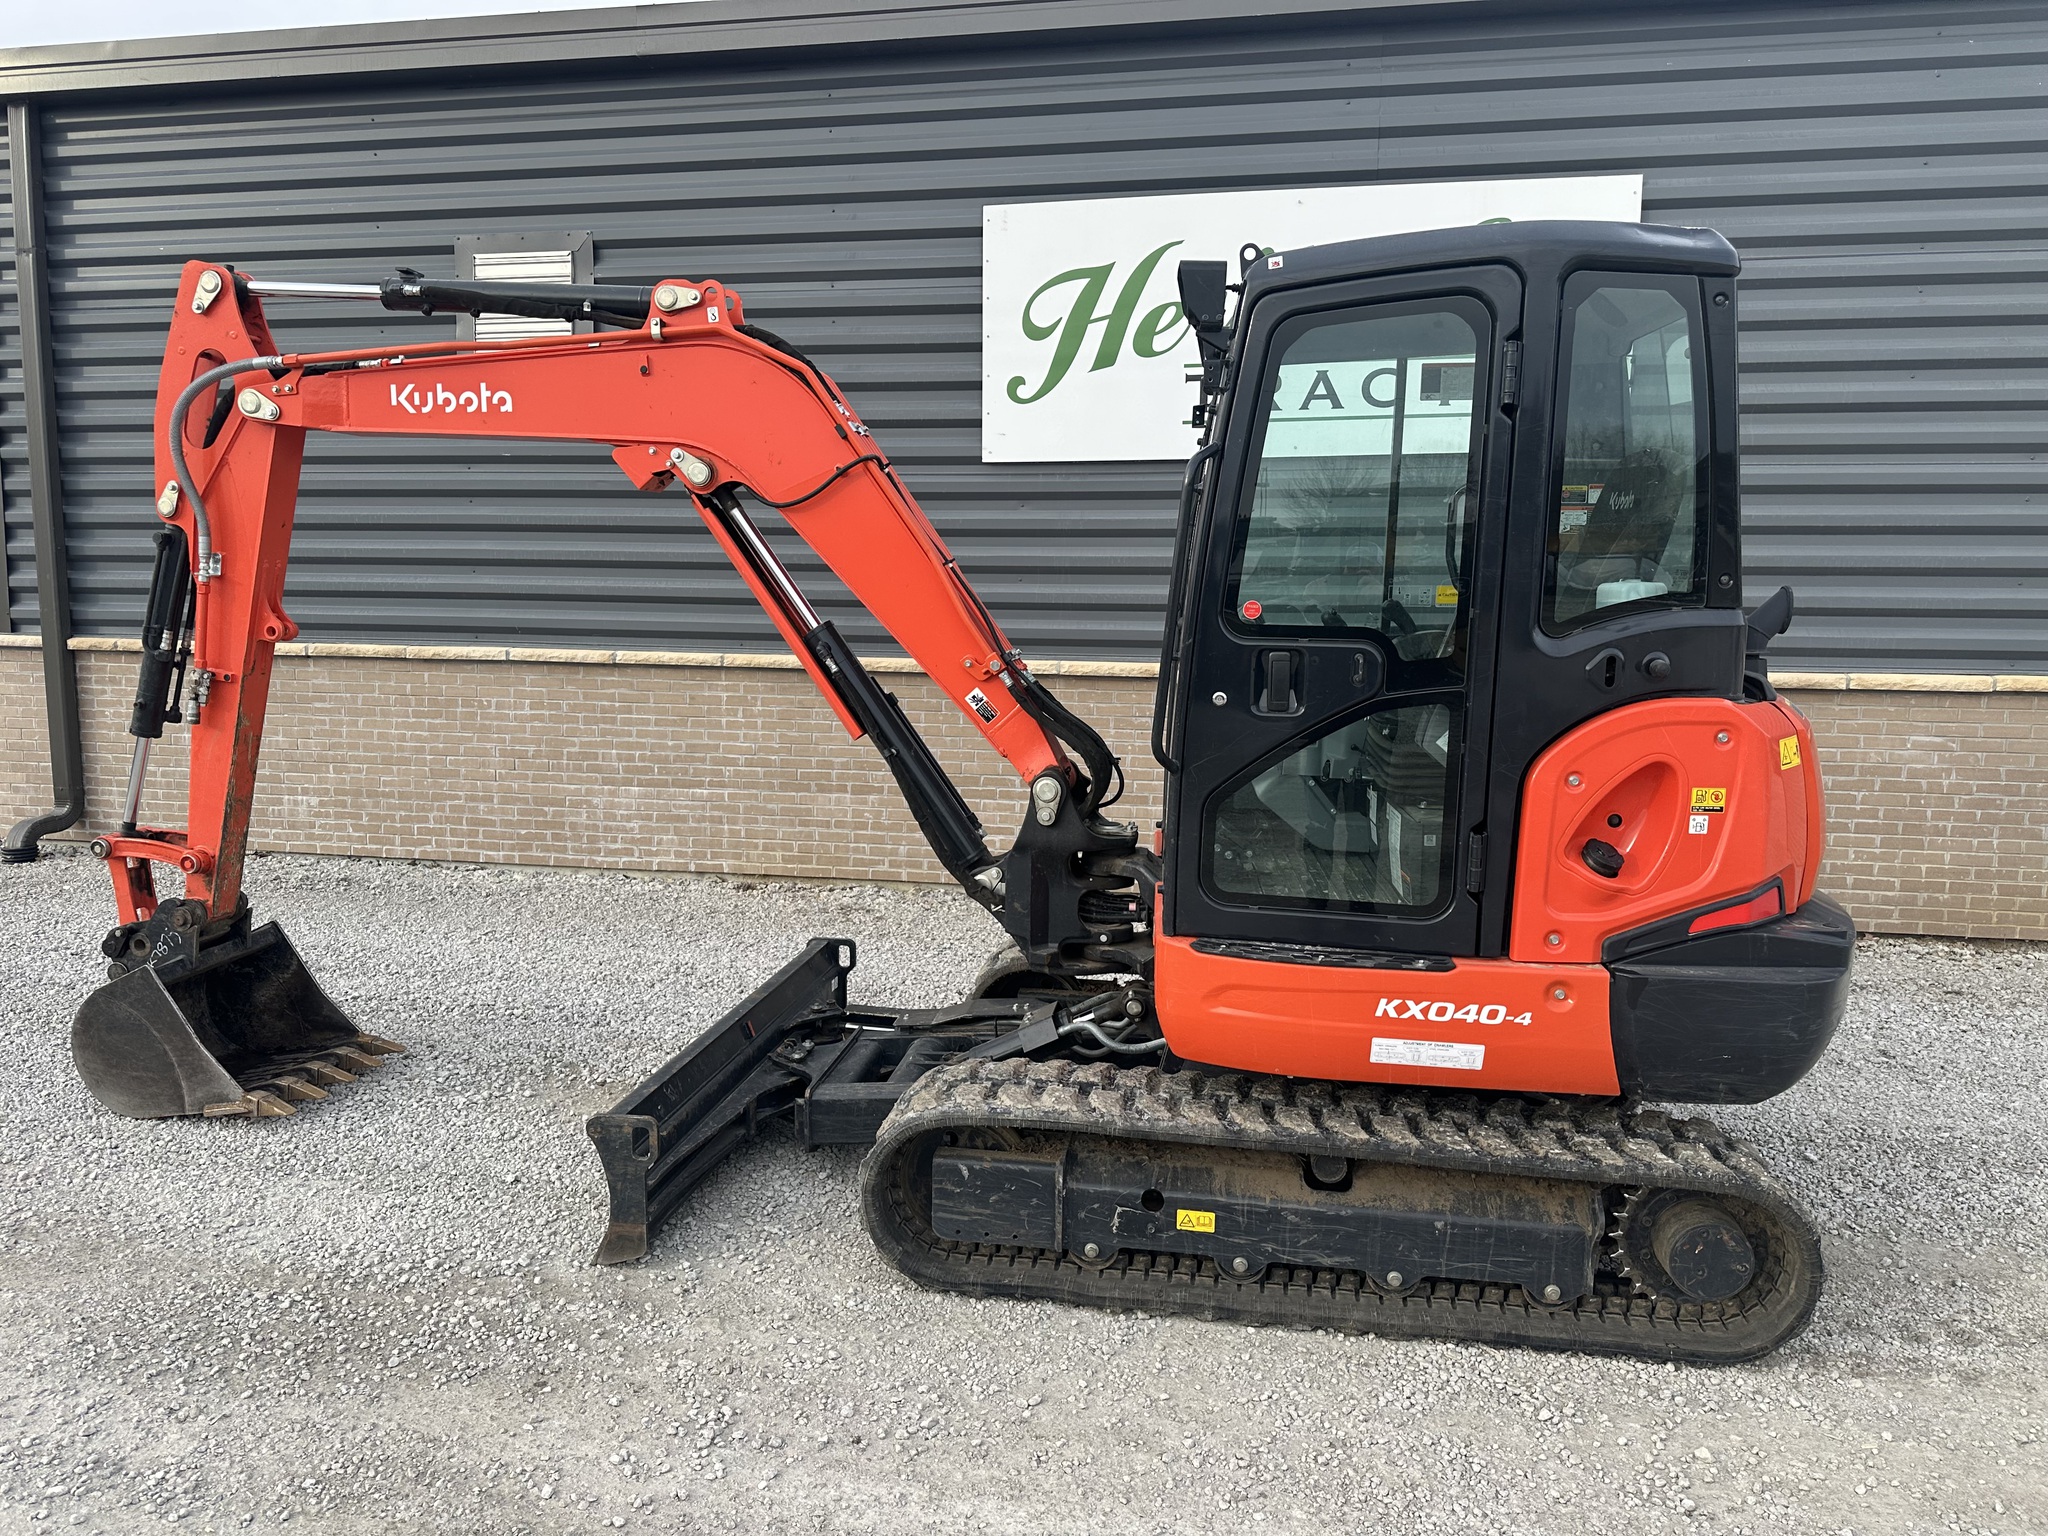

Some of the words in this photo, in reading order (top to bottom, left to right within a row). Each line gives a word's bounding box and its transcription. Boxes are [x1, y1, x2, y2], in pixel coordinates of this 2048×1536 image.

[1006, 239, 1191, 405] He
[389, 382, 513, 414] Kubota
[1374, 998, 1533, 1026] KX040-4
